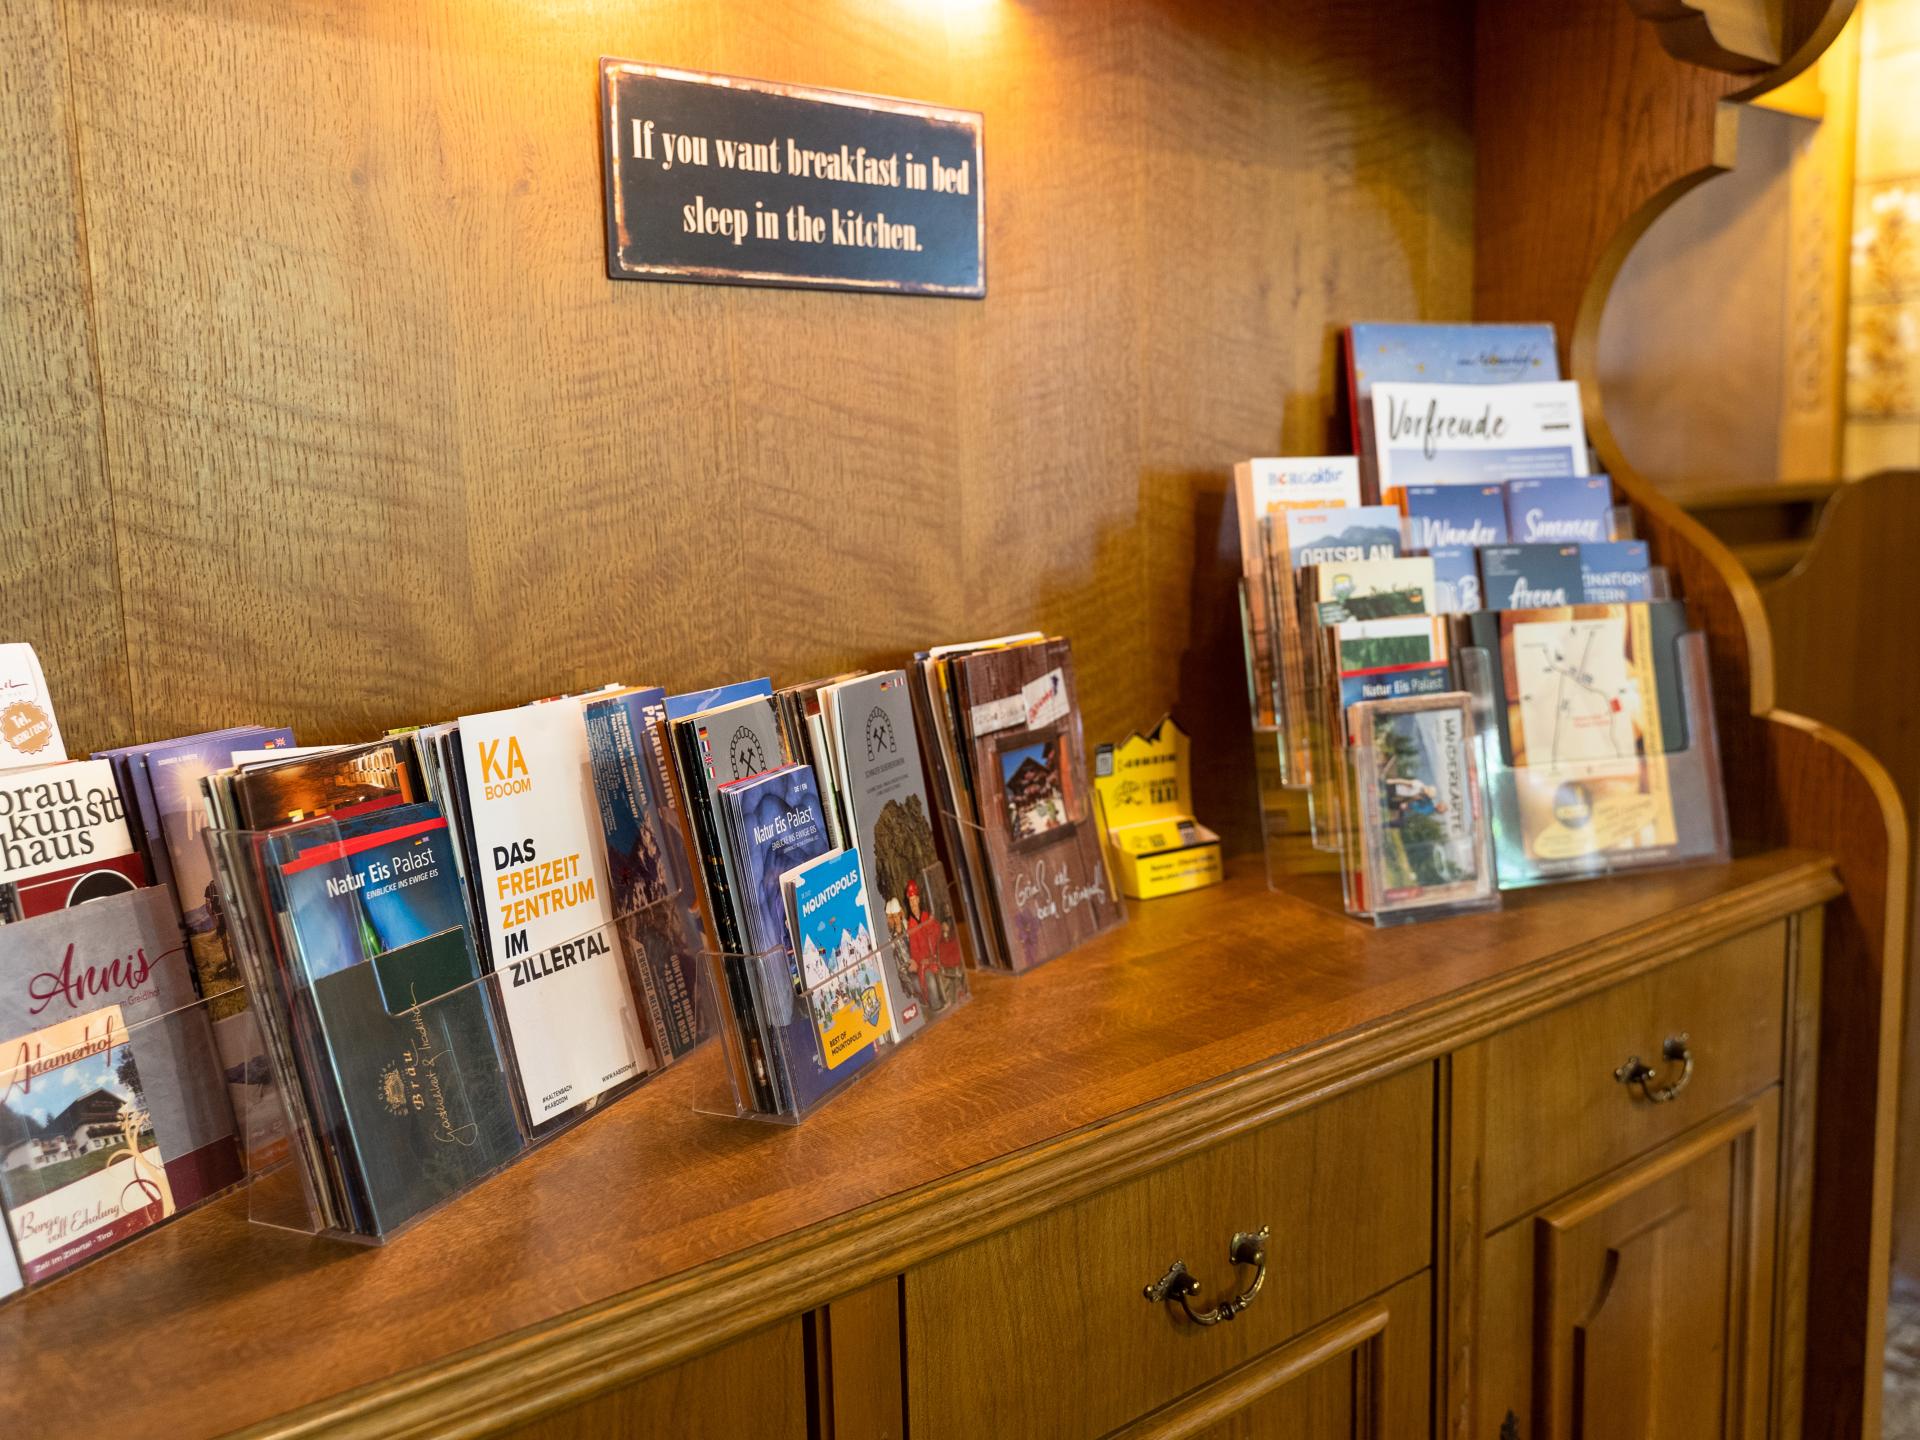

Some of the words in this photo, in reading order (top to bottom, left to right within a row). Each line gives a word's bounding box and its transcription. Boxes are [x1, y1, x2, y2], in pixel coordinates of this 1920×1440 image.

[632, 118, 655, 160] If
[662, 133, 707, 170] you
[716, 137, 781, 175] want
[787, 138, 901, 188] breakfast
[905, 153, 927, 191] in
[932, 157, 970, 195] bed
[683, 196, 748, 245] sleep
[755, 201, 779, 240] in
[786, 205, 826, 244] the
[832, 208, 924, 252] kitchen.
[1386, 394, 1507, 460] Vorfreude
[1422, 516, 1497, 547] Wander
[1524, 508, 1600, 543] Sommer
[1508, 576, 1567, 609] Arena
[1362, 680, 1393, 699] Natur
[1394, 679, 1410, 697] Eis
[1411, 676, 1444, 695] Palast
[10, 712, 32, 729] Tel.
[478, 736, 529, 784] KA
[1444, 716, 1465, 834] WANDERKARTE
[485, 778, 532, 801] BOOOM
[754, 824, 774, 845] Natur
[775, 815, 787, 834] Eis
[787, 805, 814, 829] Palast
[0, 830, 95, 872] haus
[493, 838, 536, 871] DAS
[326, 871, 366, 898] Natur
[368, 862, 390, 883] Eis
[392, 848, 436, 875] Palast
[366, 882, 397, 900] EINBLICKE
[398, 877, 408, 889] INS
[408, 872, 429, 887] EWIGE
[429, 868, 439, 879] EIS
[497, 854, 580, 900] FREIZEIT
[802, 870, 858, 918] MOUNTOPOLIS
[500, 878, 596, 929] ZENTRUM
[505, 929, 529, 959] IM
[509, 932, 610, 988] ZILLERTAL
[30, 943, 187, 1014] Annis
[70, 1200, 120, 1232] Erholung
